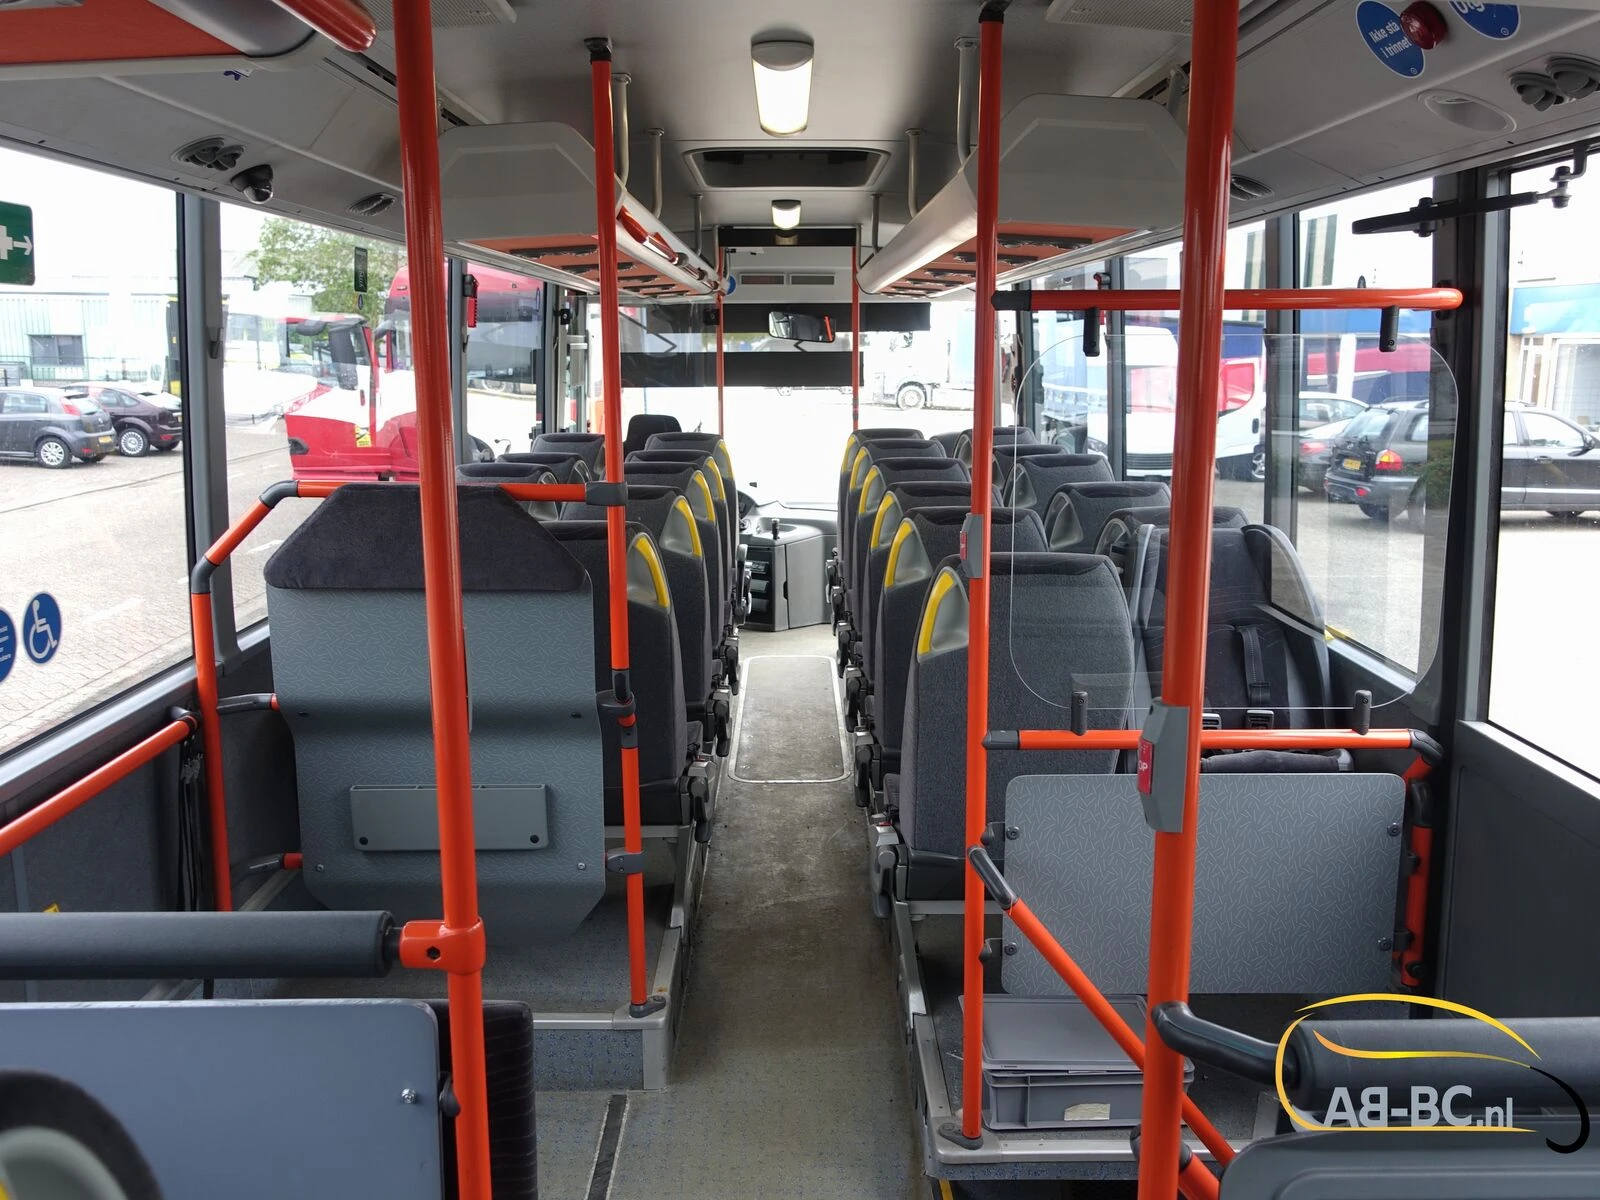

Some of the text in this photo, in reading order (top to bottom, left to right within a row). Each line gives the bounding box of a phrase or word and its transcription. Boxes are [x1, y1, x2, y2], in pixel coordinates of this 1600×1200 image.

[1452, 0, 1485, 13] Utg
[1369, 29, 1388, 43] Ikke
[1385, 36, 1412, 56] trinnet
